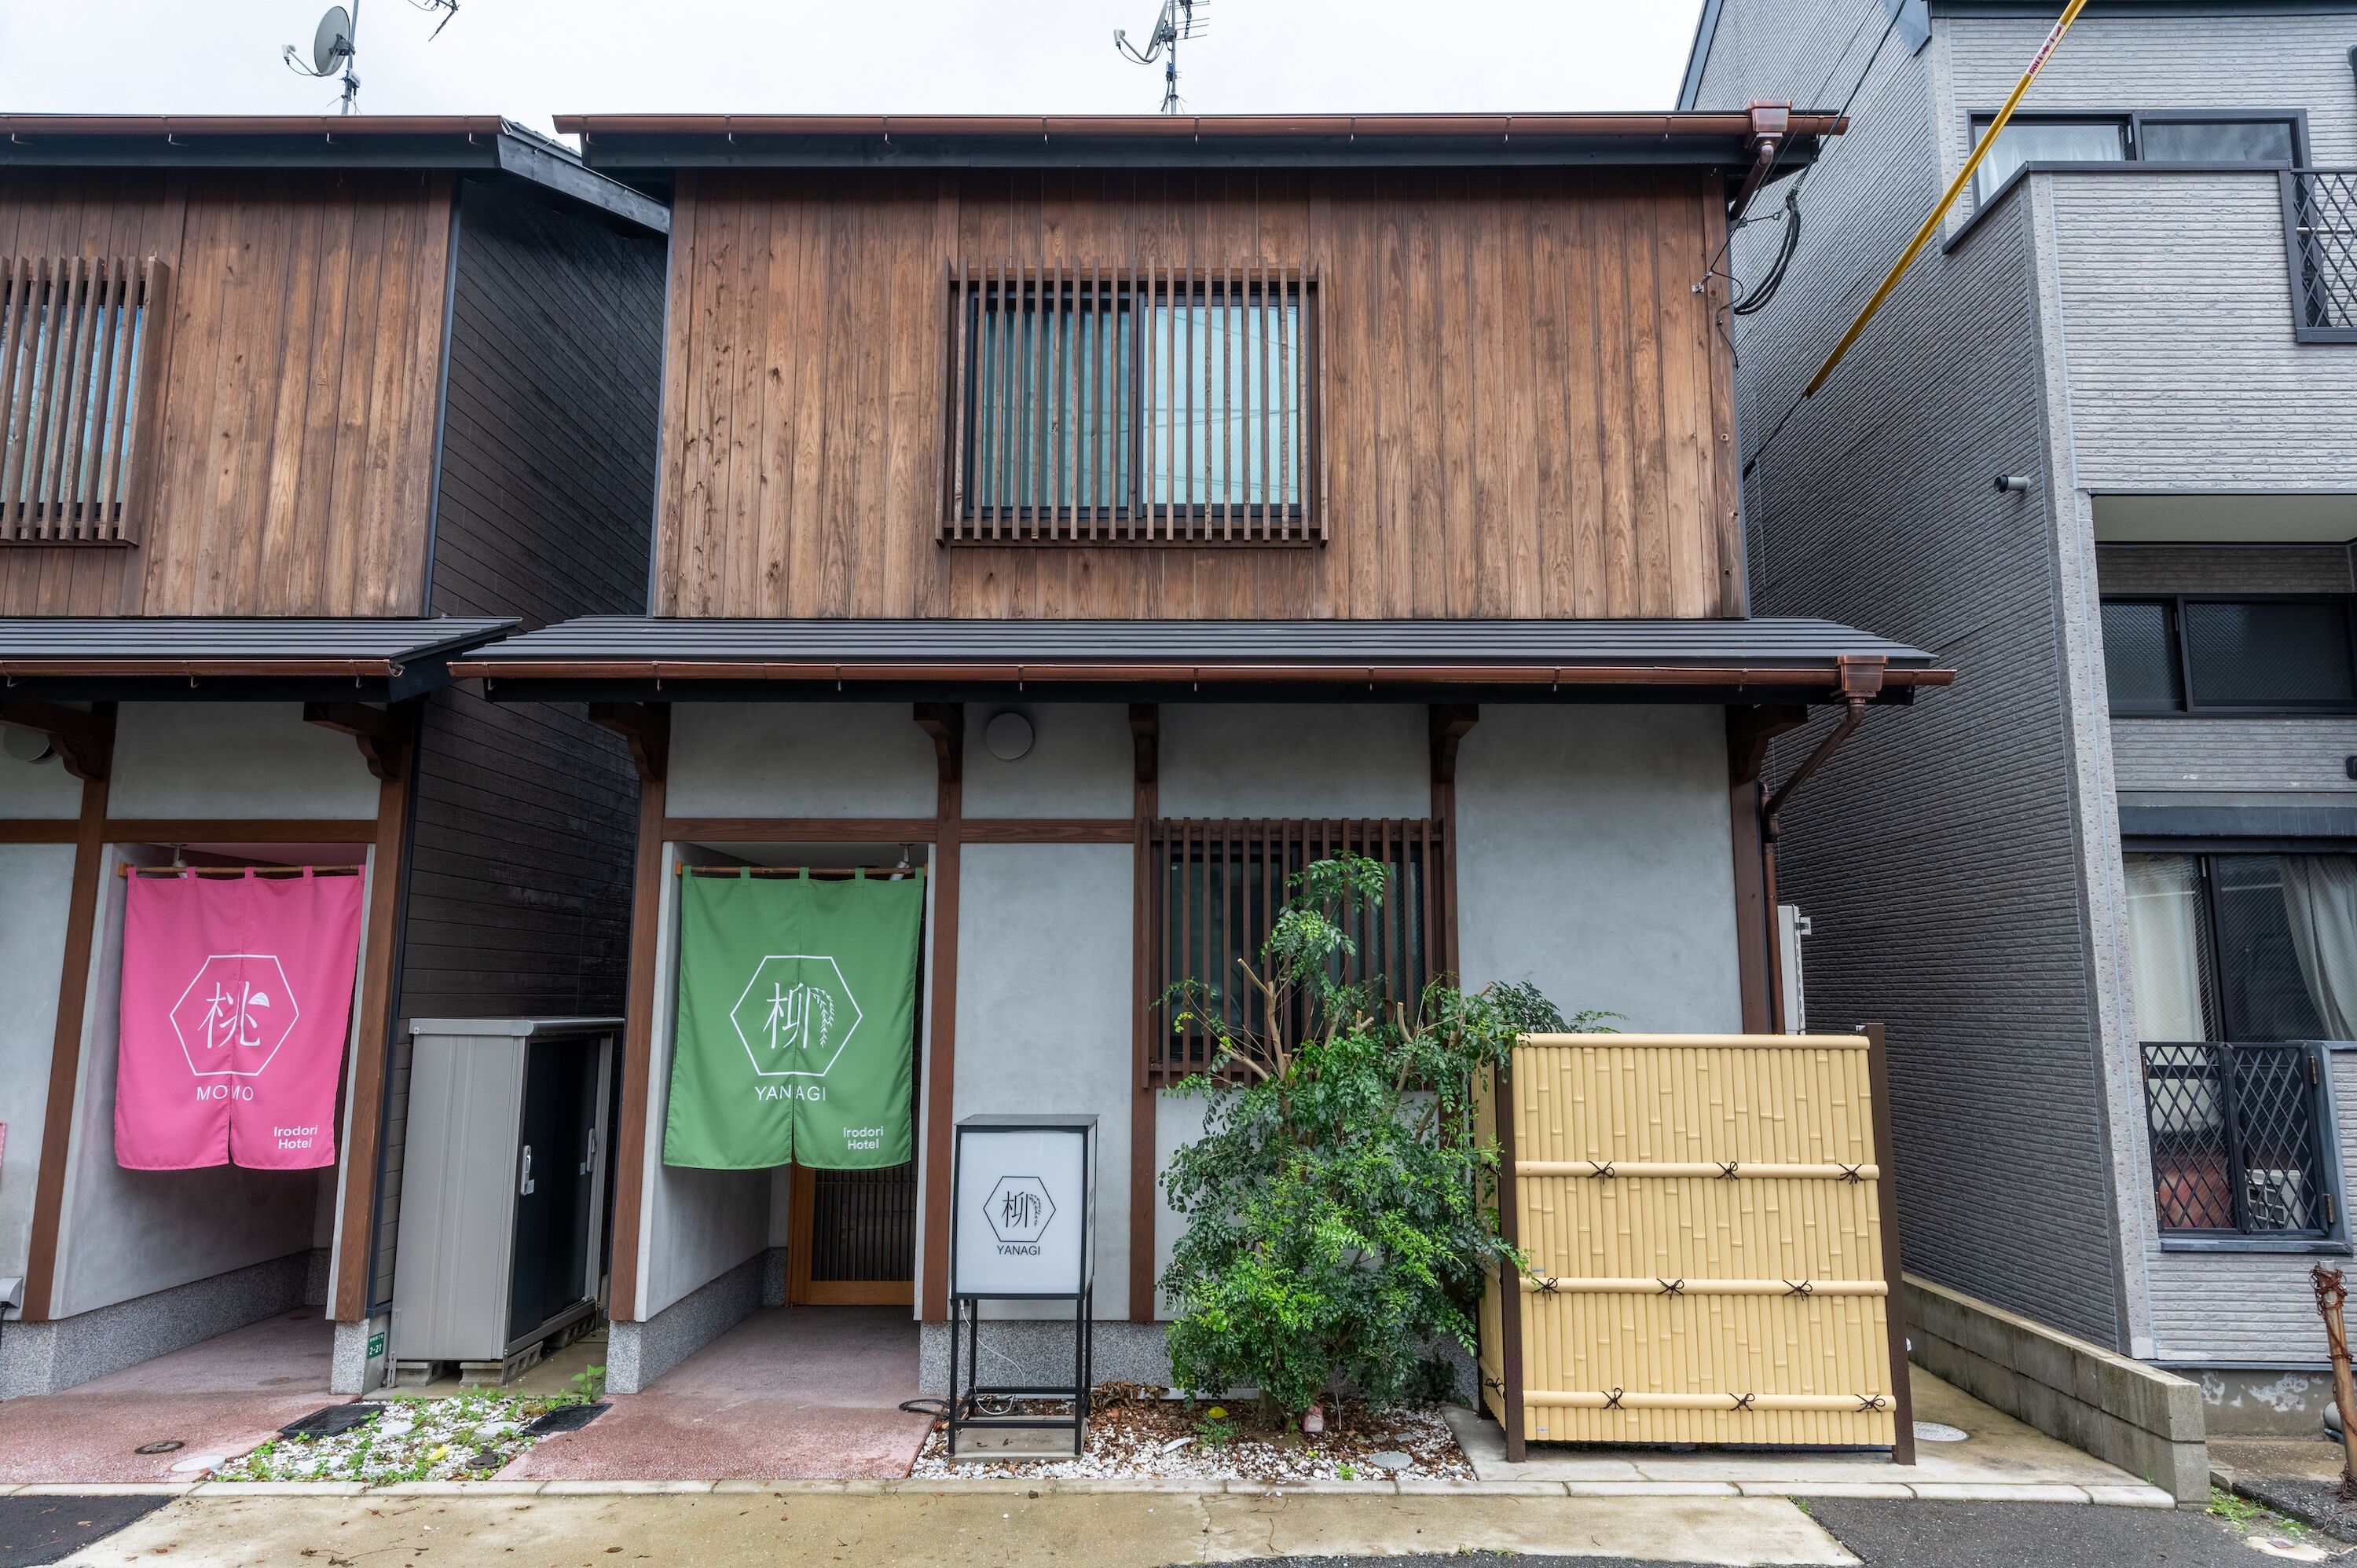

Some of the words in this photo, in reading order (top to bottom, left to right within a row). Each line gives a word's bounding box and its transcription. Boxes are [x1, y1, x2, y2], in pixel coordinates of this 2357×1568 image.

[197, 980, 270, 1050] 桃
[762, 981, 835, 1050] 柳
[196, 1084, 254, 1101] MOMO
[754, 1084, 826, 1101] YANAGI
[273, 1124, 318, 1137] Irodori
[843, 1126, 884, 1138] Irodori
[277, 1138, 312, 1149] Hotel
[847, 1138, 879, 1149] Hotel
[996, 1245, 1040, 1256] YANAGI
[368, 1343, 382, 1356] 2-21
